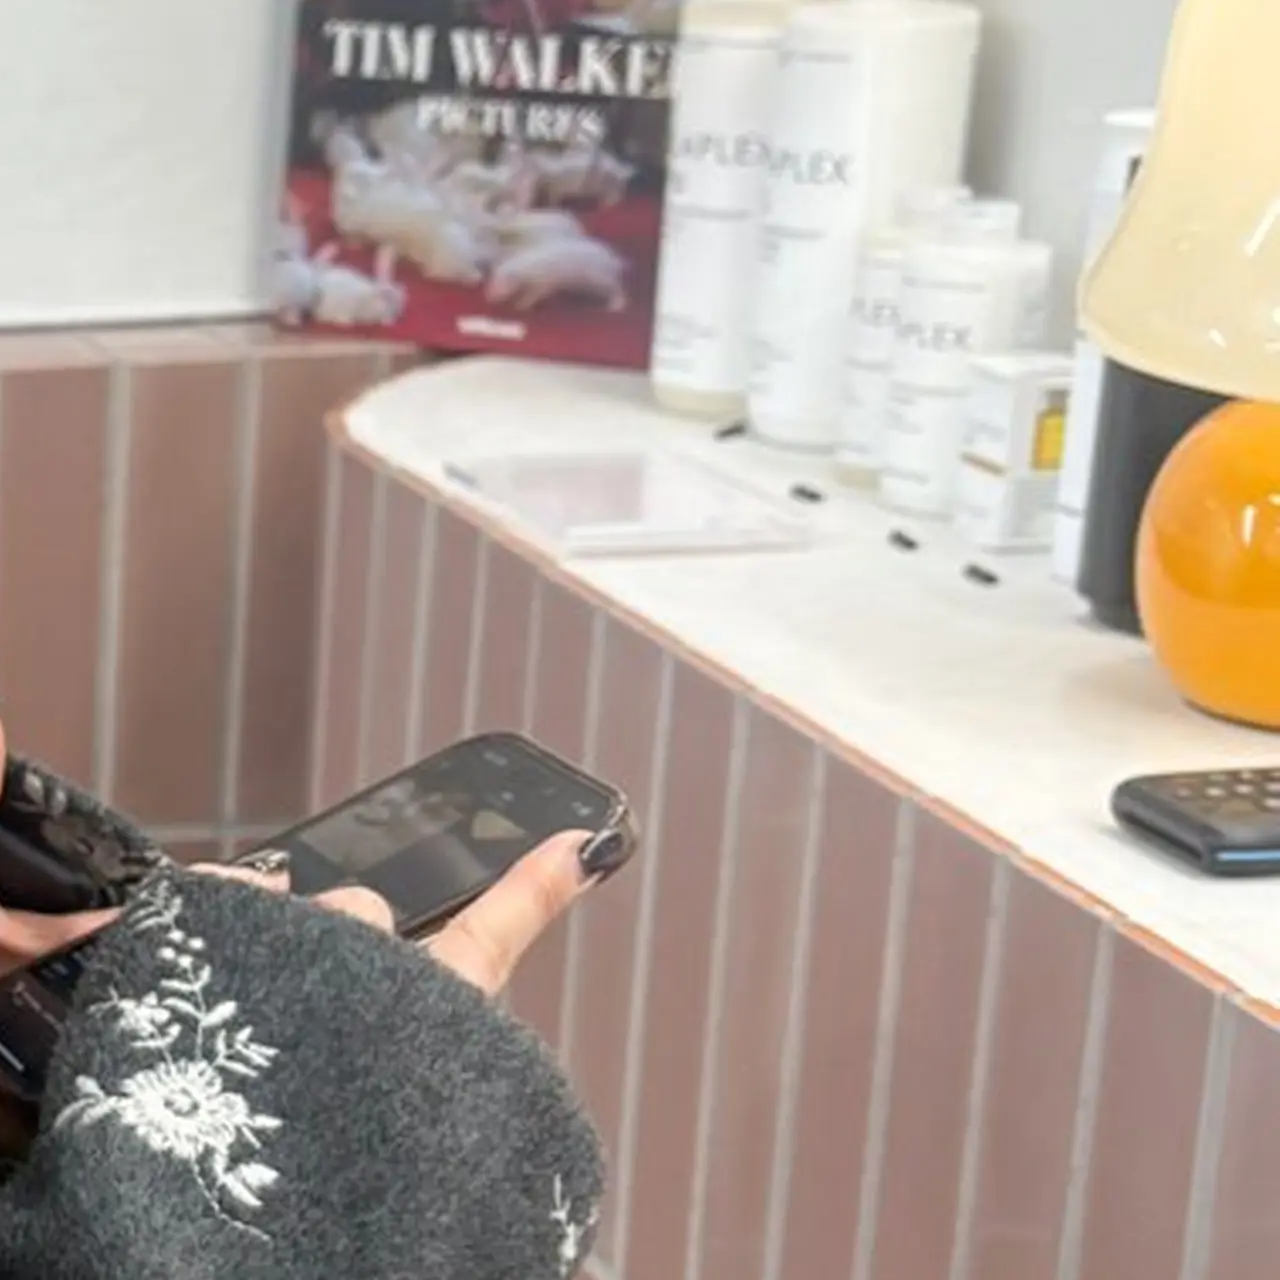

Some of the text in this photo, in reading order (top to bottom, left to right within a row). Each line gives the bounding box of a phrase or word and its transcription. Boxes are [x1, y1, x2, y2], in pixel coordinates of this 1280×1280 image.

[324, 19, 673, 98] TIM WALKE
[416, 95, 604, 144] PICTURES
